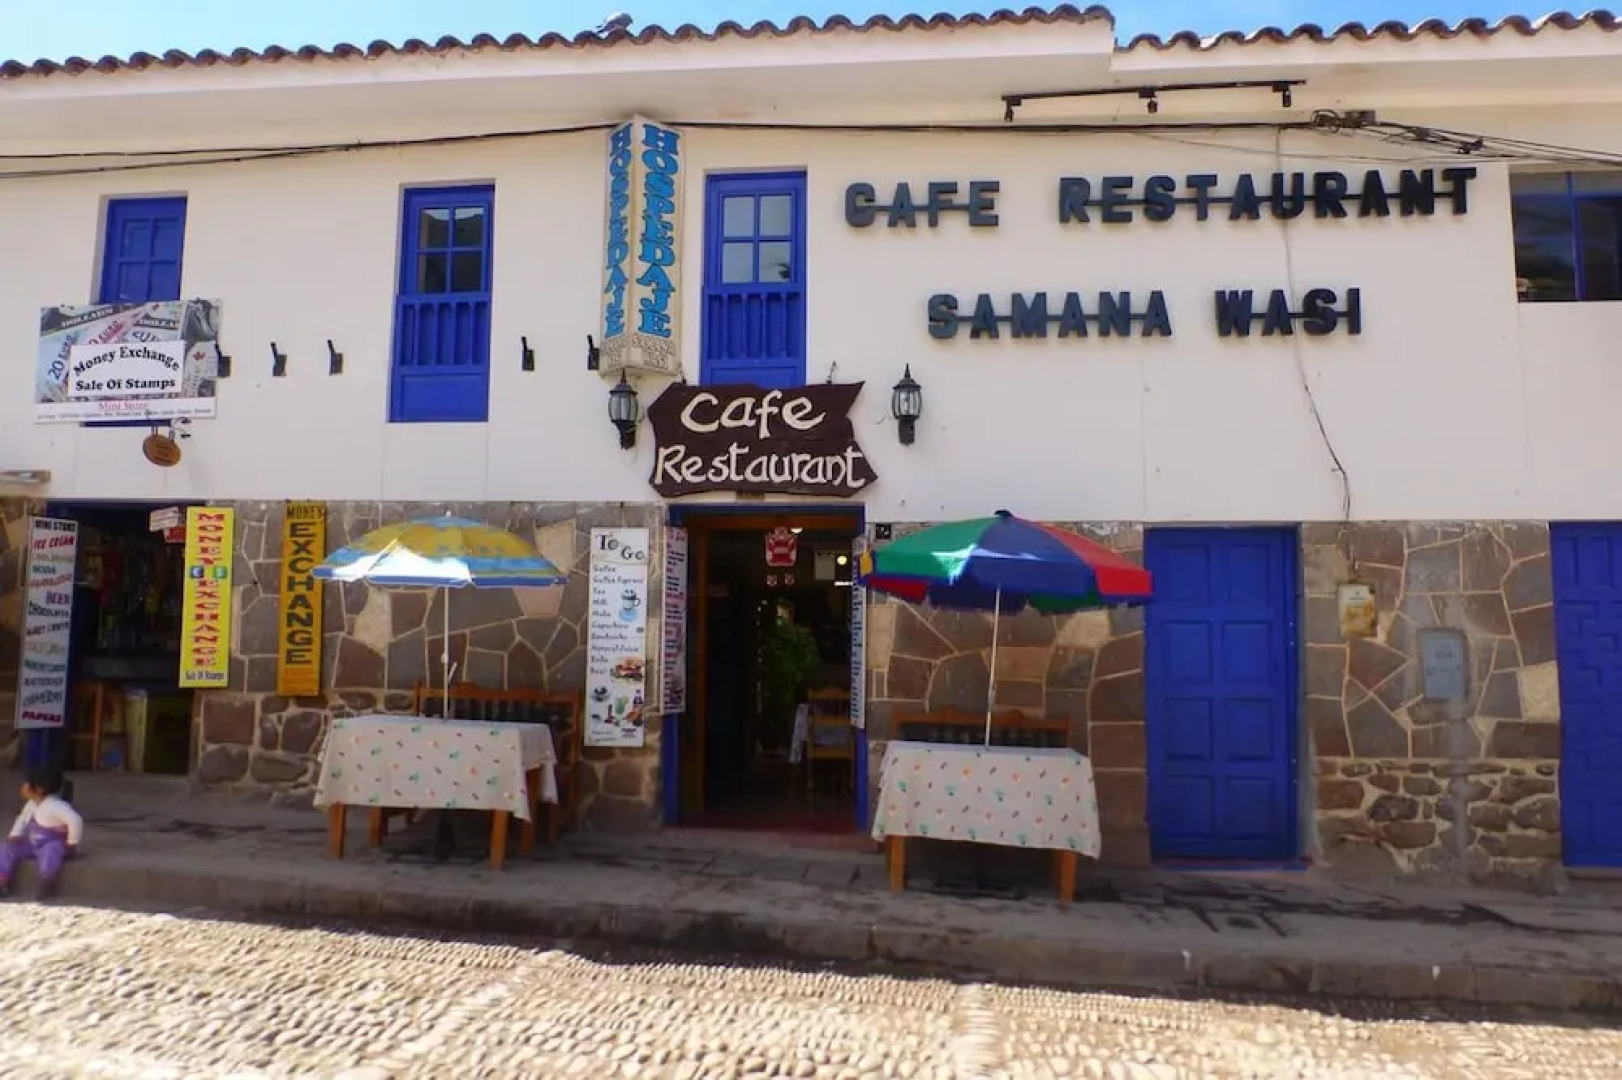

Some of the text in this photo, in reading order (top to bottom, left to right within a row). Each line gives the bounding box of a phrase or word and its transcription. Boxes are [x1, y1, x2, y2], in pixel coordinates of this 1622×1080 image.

[605, 123, 632, 338] HOSPEDAJE
[636, 124, 679, 337] HOSPEDAJE
[844, 166, 1476, 228] CAFE RESTAURANT
[926, 286, 1361, 338] SAMANA WASI
[73, 346, 180, 377] Money Exchange
[75, 378, 176, 391] Sale Of Stamps
[654, 390, 867, 487] Cafe Restaurant
[286, 505, 325, 519] MONEY
[193, 580, 222, 666] EXCHANGE
[285, 522, 317, 664] EXCHANGE
